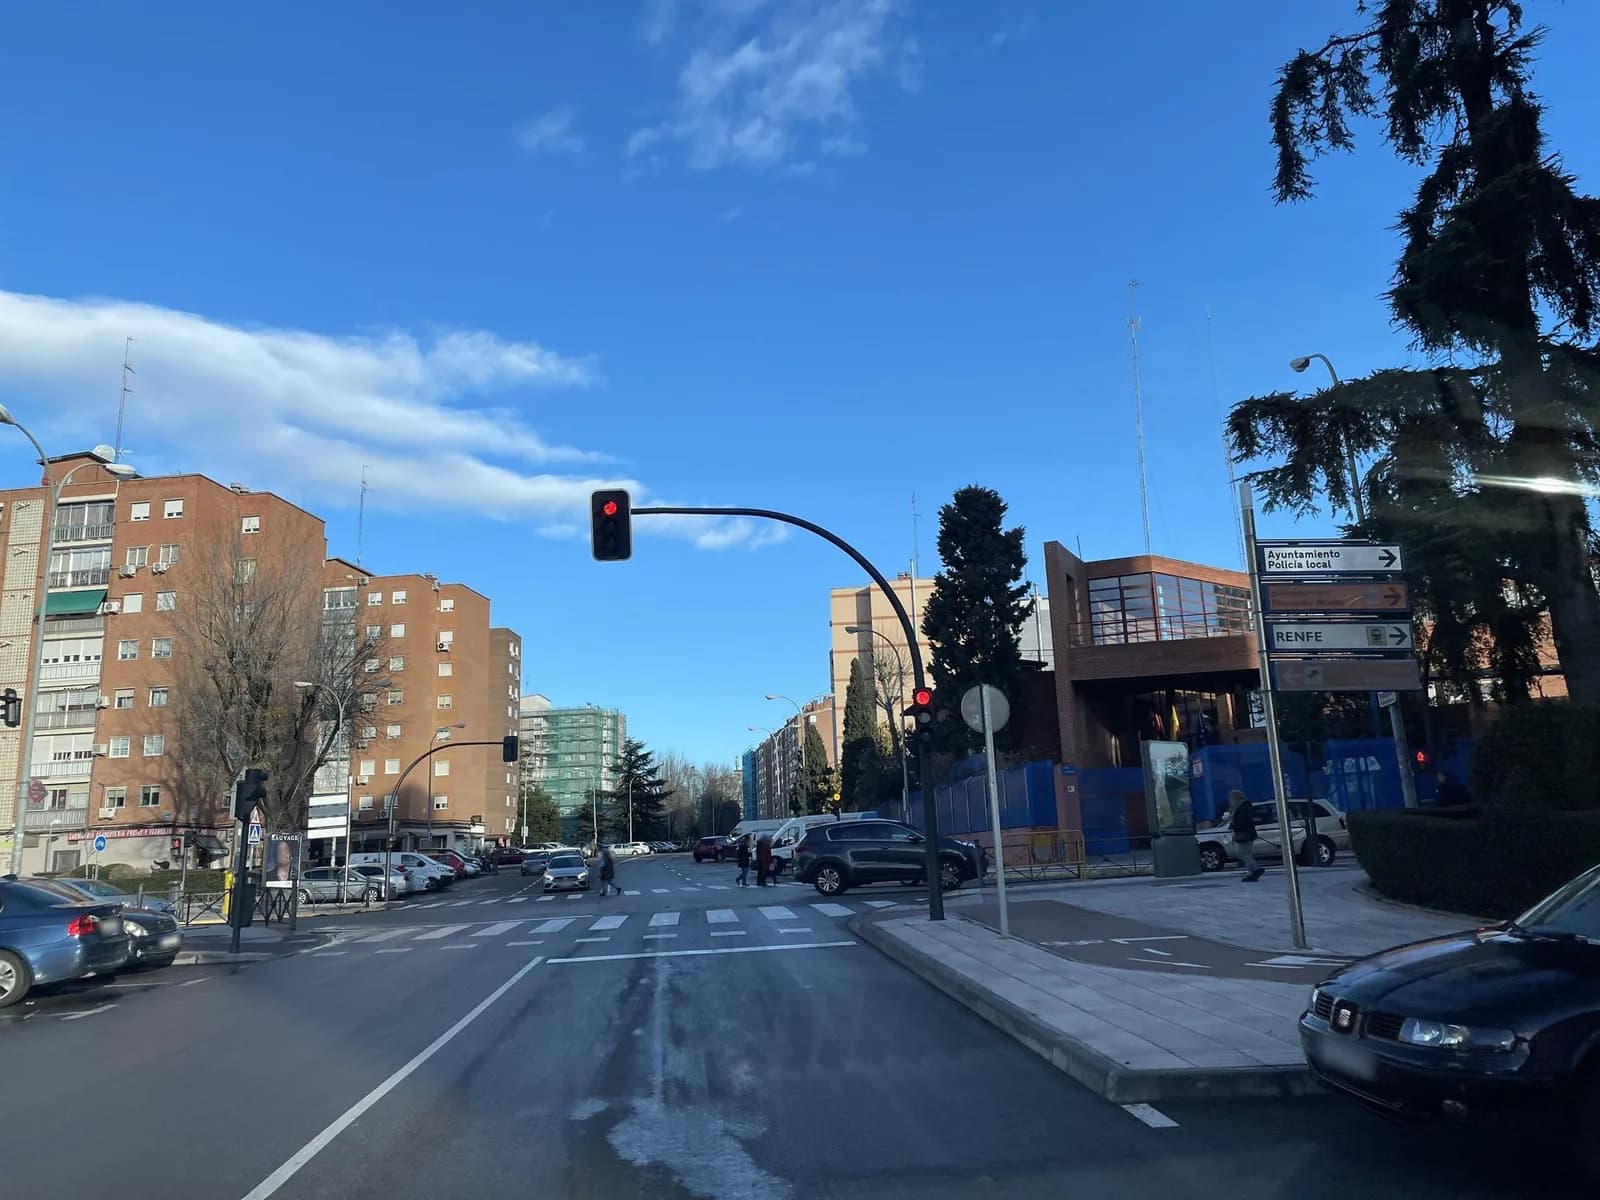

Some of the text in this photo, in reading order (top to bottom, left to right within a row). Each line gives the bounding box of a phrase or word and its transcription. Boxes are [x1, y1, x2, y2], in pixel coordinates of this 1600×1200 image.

[1268, 550, 1341, 560] Ayuntamiento
[1306, 560, 1332, 569] local
[1276, 631, 1323, 642] RENFE
